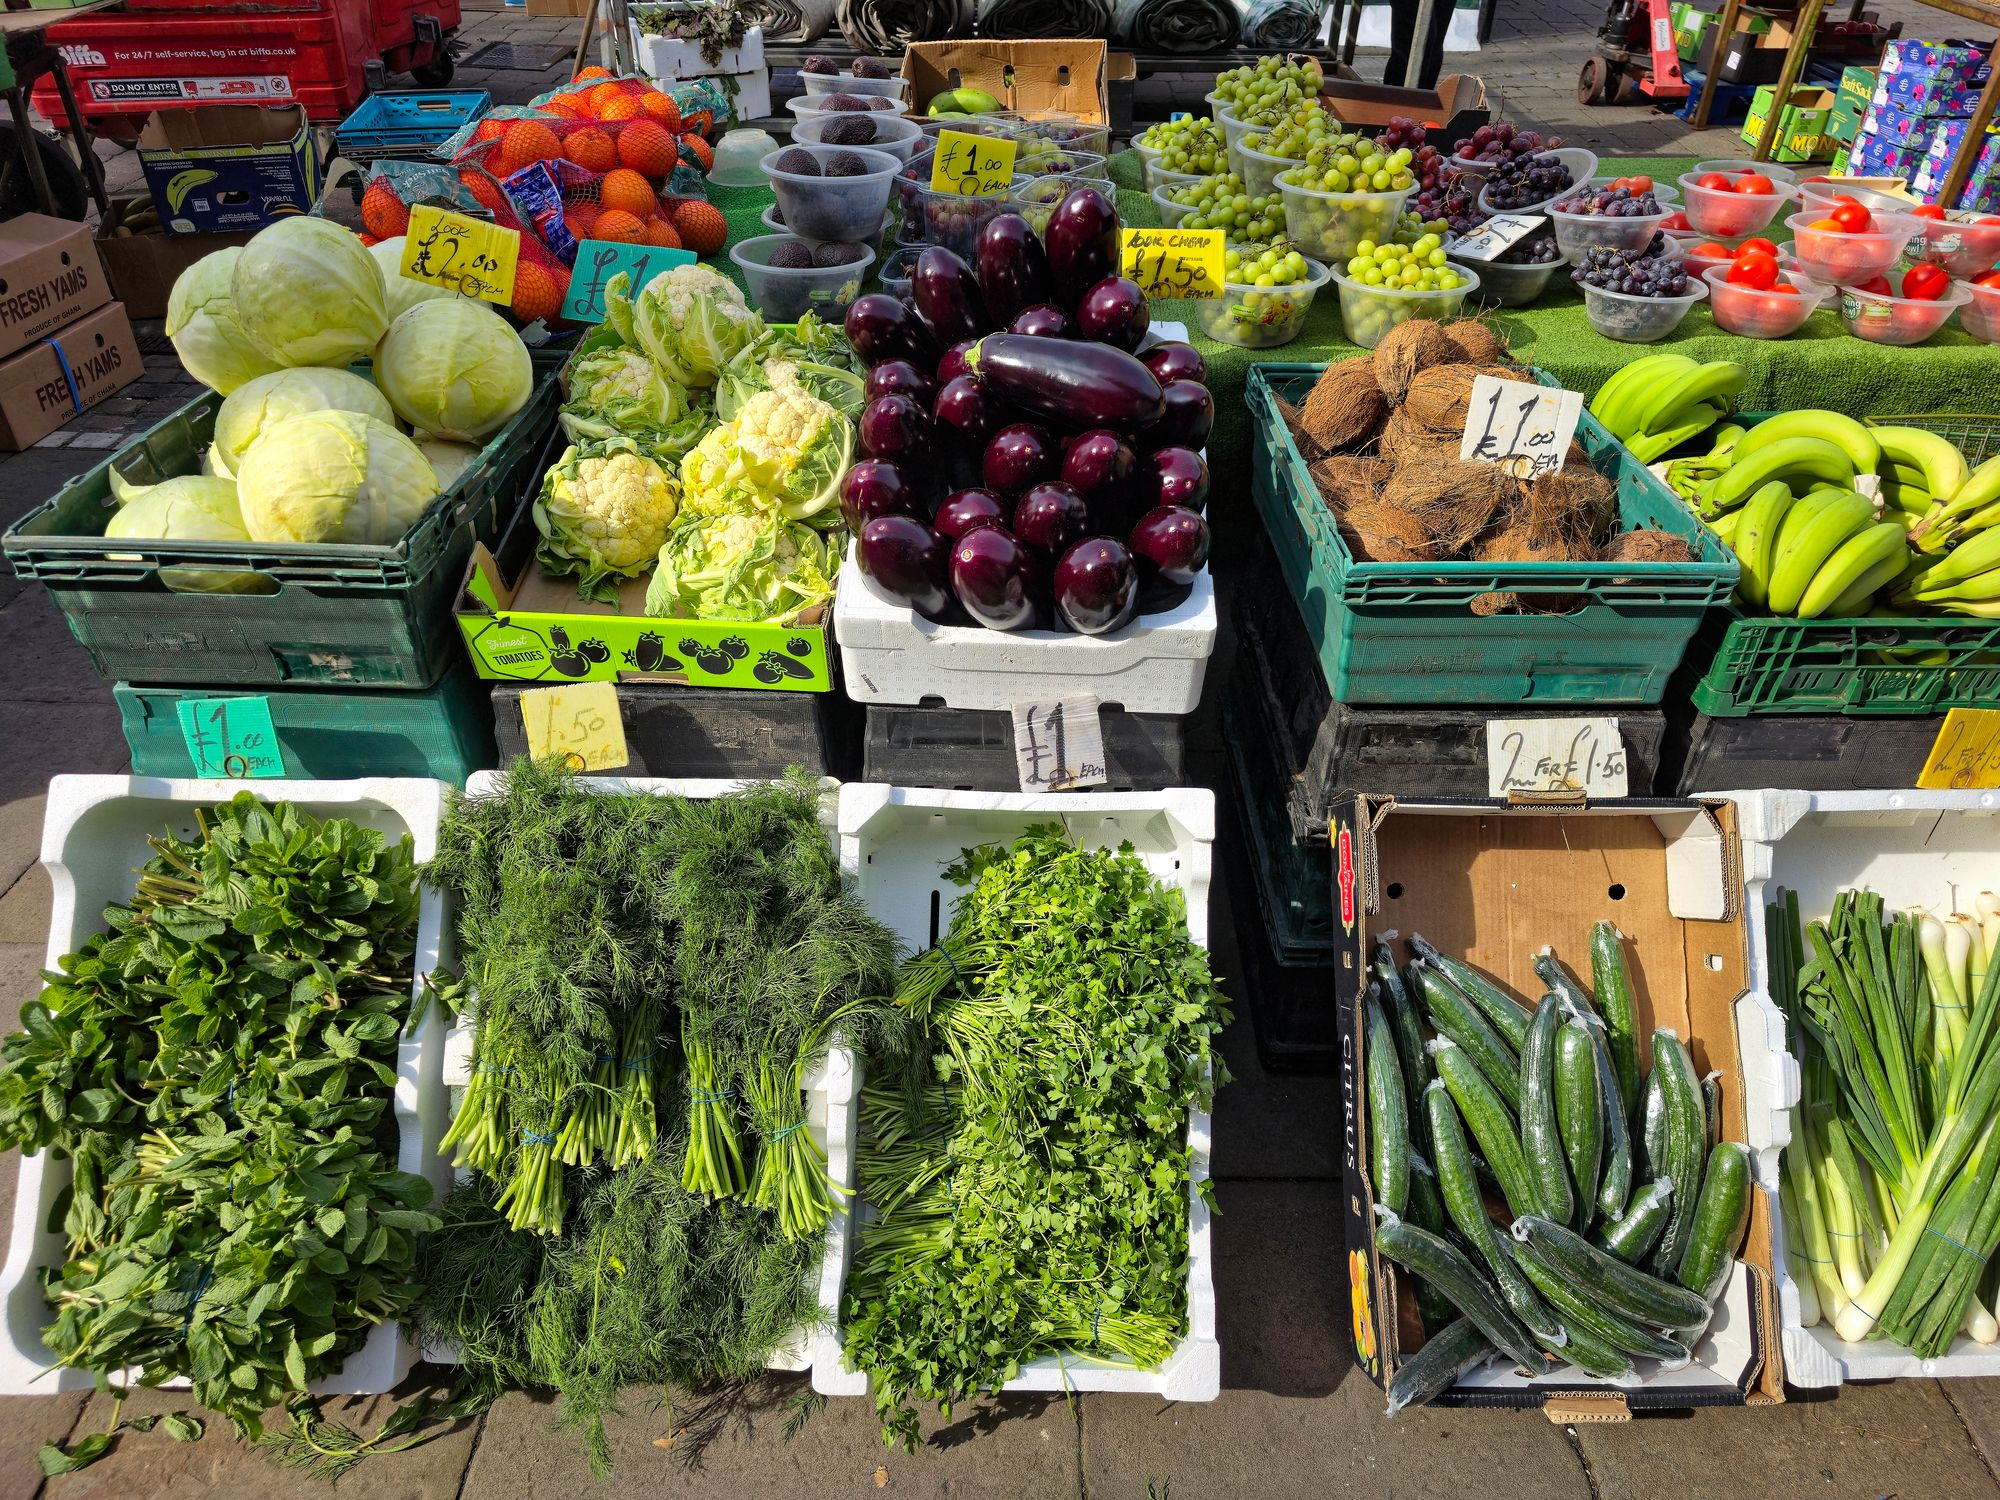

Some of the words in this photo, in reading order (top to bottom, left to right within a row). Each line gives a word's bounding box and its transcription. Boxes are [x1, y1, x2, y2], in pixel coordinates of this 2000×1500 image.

[114, 51, 130, 60] For
[131, 50, 152, 60] 24/7
[154, 49, 210, 60] self-service,
[211, 48, 226, 59] log
[227, 48, 237, 57] in
[238, 48, 248, 57] at
[250, 46, 296, 57] biffa.co.uk
[111, 84, 125, 92] DO
[126, 83, 146, 91] NOT
[147, 83, 178, 91] ENTER
[940, 140, 1003, 181] £1.00
[982, 179, 1010, 193] EACH
[574, 247, 651, 317] £1
[1128, 248, 1207, 293] £1.50
[0, 283, 51, 328] FRESH
[49, 265, 88, 302] YAMS
[1183, 289, 1214, 299] EACH
[24, 318, 53, 339] PRODUCE
[53, 314, 61, 323] OF
[61, 304, 82, 318] GHANA
[35, 366, 86, 412] FREH
[84, 345, 122, 383] YAMS
[61, 399, 88, 421] PRODCE
[88, 395, 97, 405] OF
[96, 382, 117, 398] GHANA
[492, 649, 545, 666] TOMATOES
[1391, 654, 1483, 674] LABEL
[1020, 701, 1077, 790] £1
[1500, 731, 1536, 791] 2
[1534, 756, 1562, 777] FOR
[1341, 838, 1349, 916] DOMAINES
[1343, 1033, 1355, 1170] CITRUS
